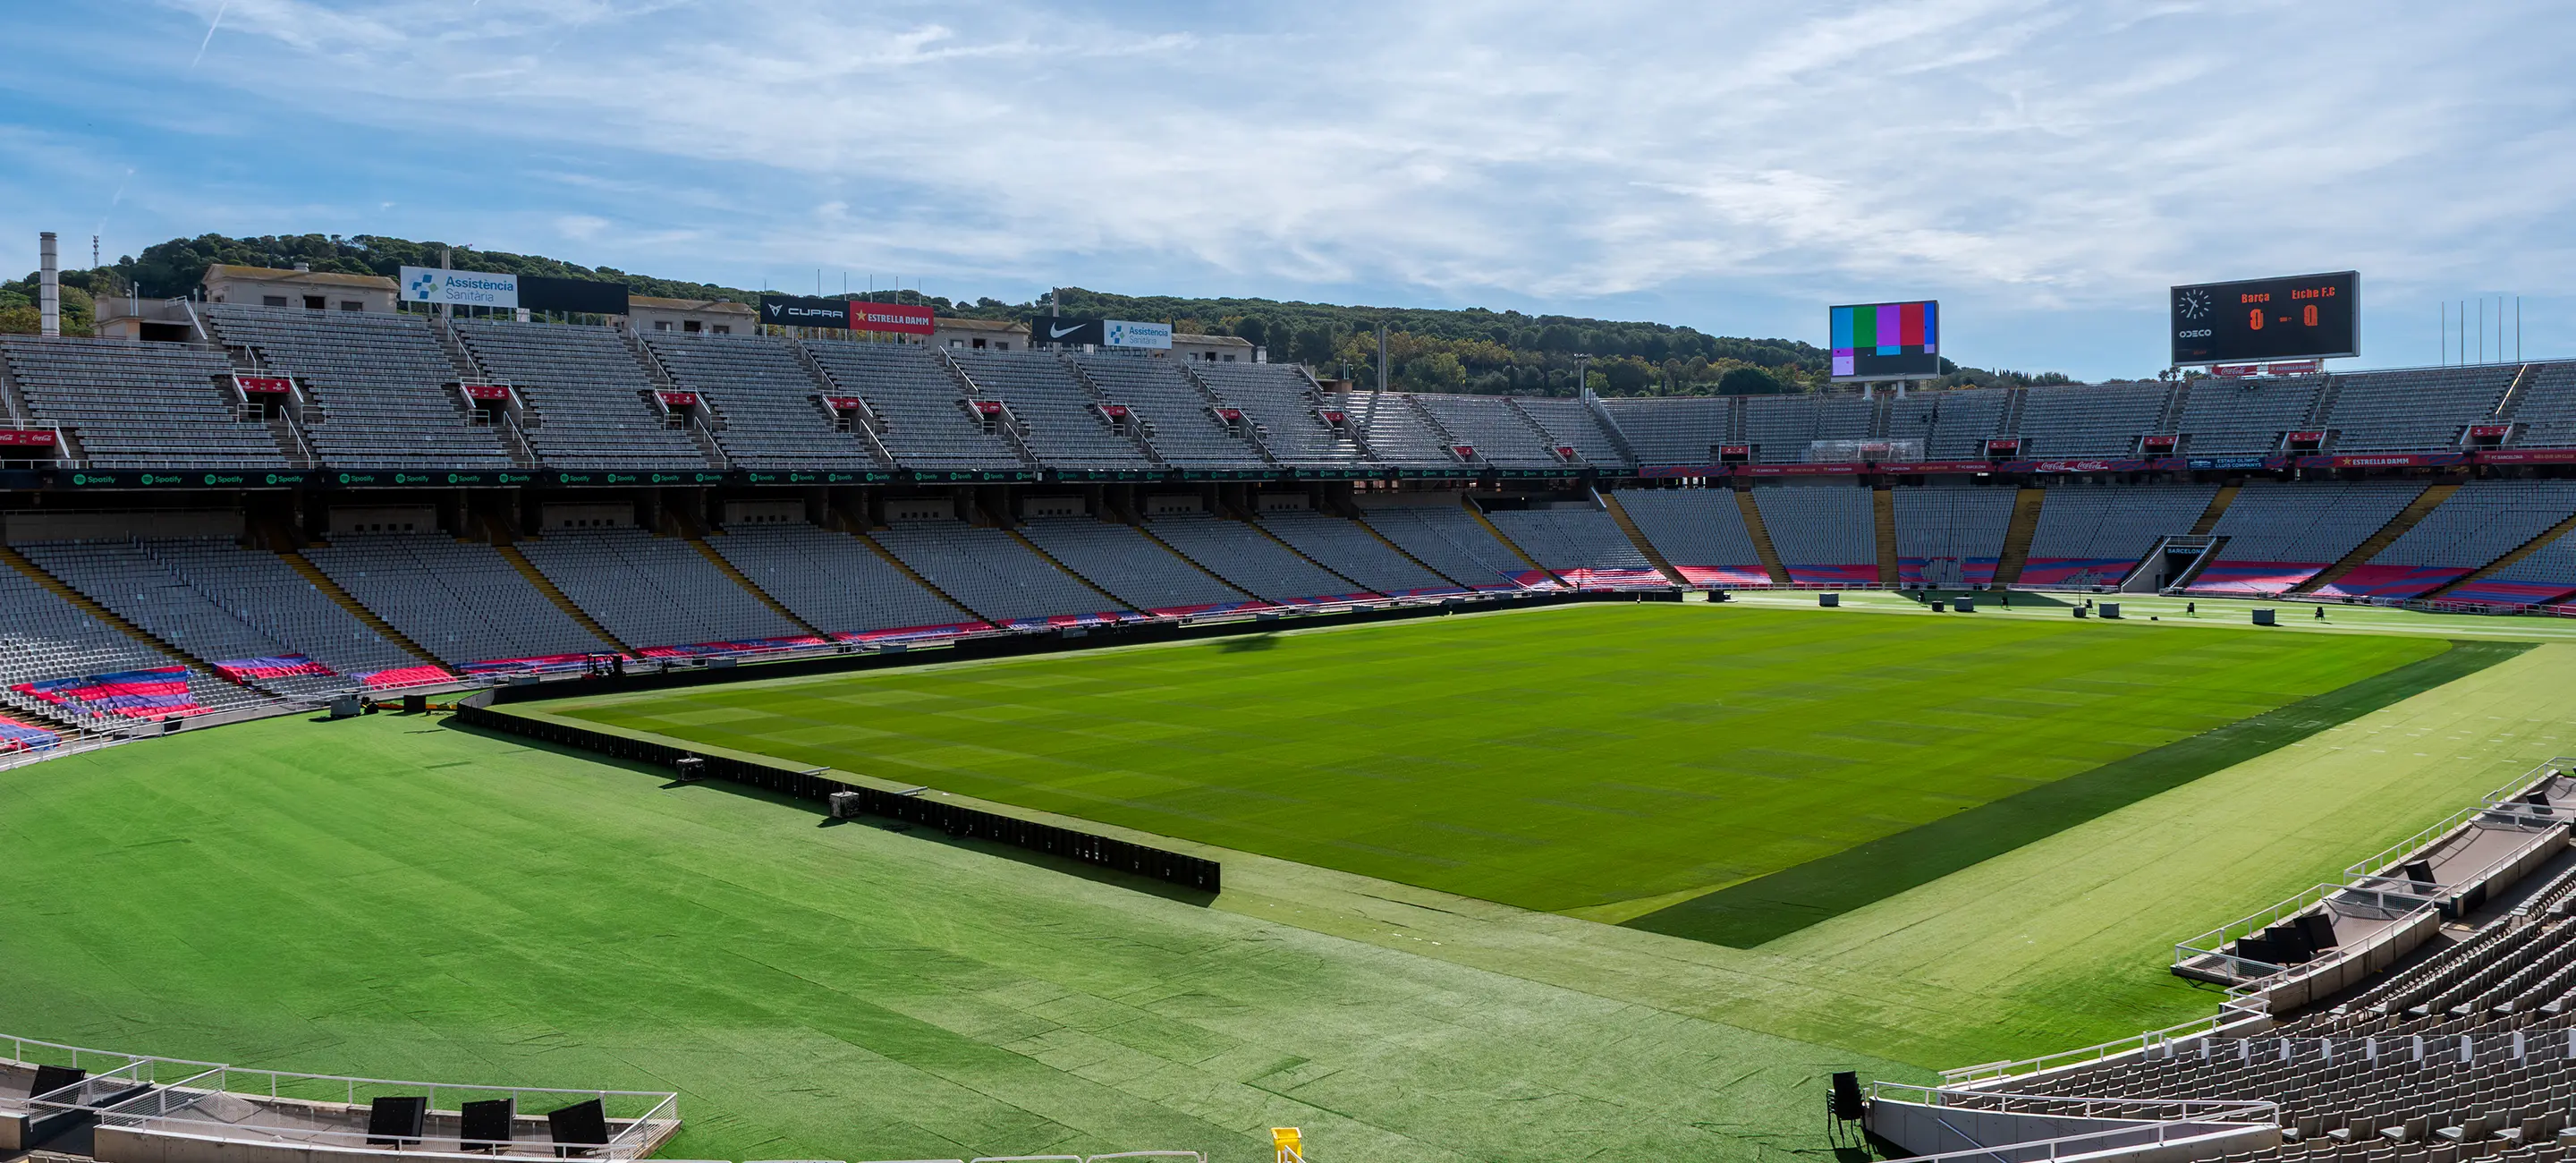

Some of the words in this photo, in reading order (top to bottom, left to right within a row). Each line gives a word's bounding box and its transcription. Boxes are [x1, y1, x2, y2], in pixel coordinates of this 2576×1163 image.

[445, 276, 514, 292] Assistència
[445, 288, 495, 302] Sanitària
[2241, 293, 2270, 304] Barça
[788, 308, 843, 318] CUPRA
[868, 313, 904, 324] ESTRELLA
[905, 316, 929, 326] DAMM
[1129, 327, 1168, 337] Assistència
[2179, 328, 2212, 338] ODECO
[88, 476, 115, 484] Spotify
[156, 476, 182, 484] Spotify
[217, 476, 243, 484] Spotify
[278, 476, 304, 484] Spotify
[351, 475, 375, 483] Spotify
[406, 475, 429, 483] Spotify
